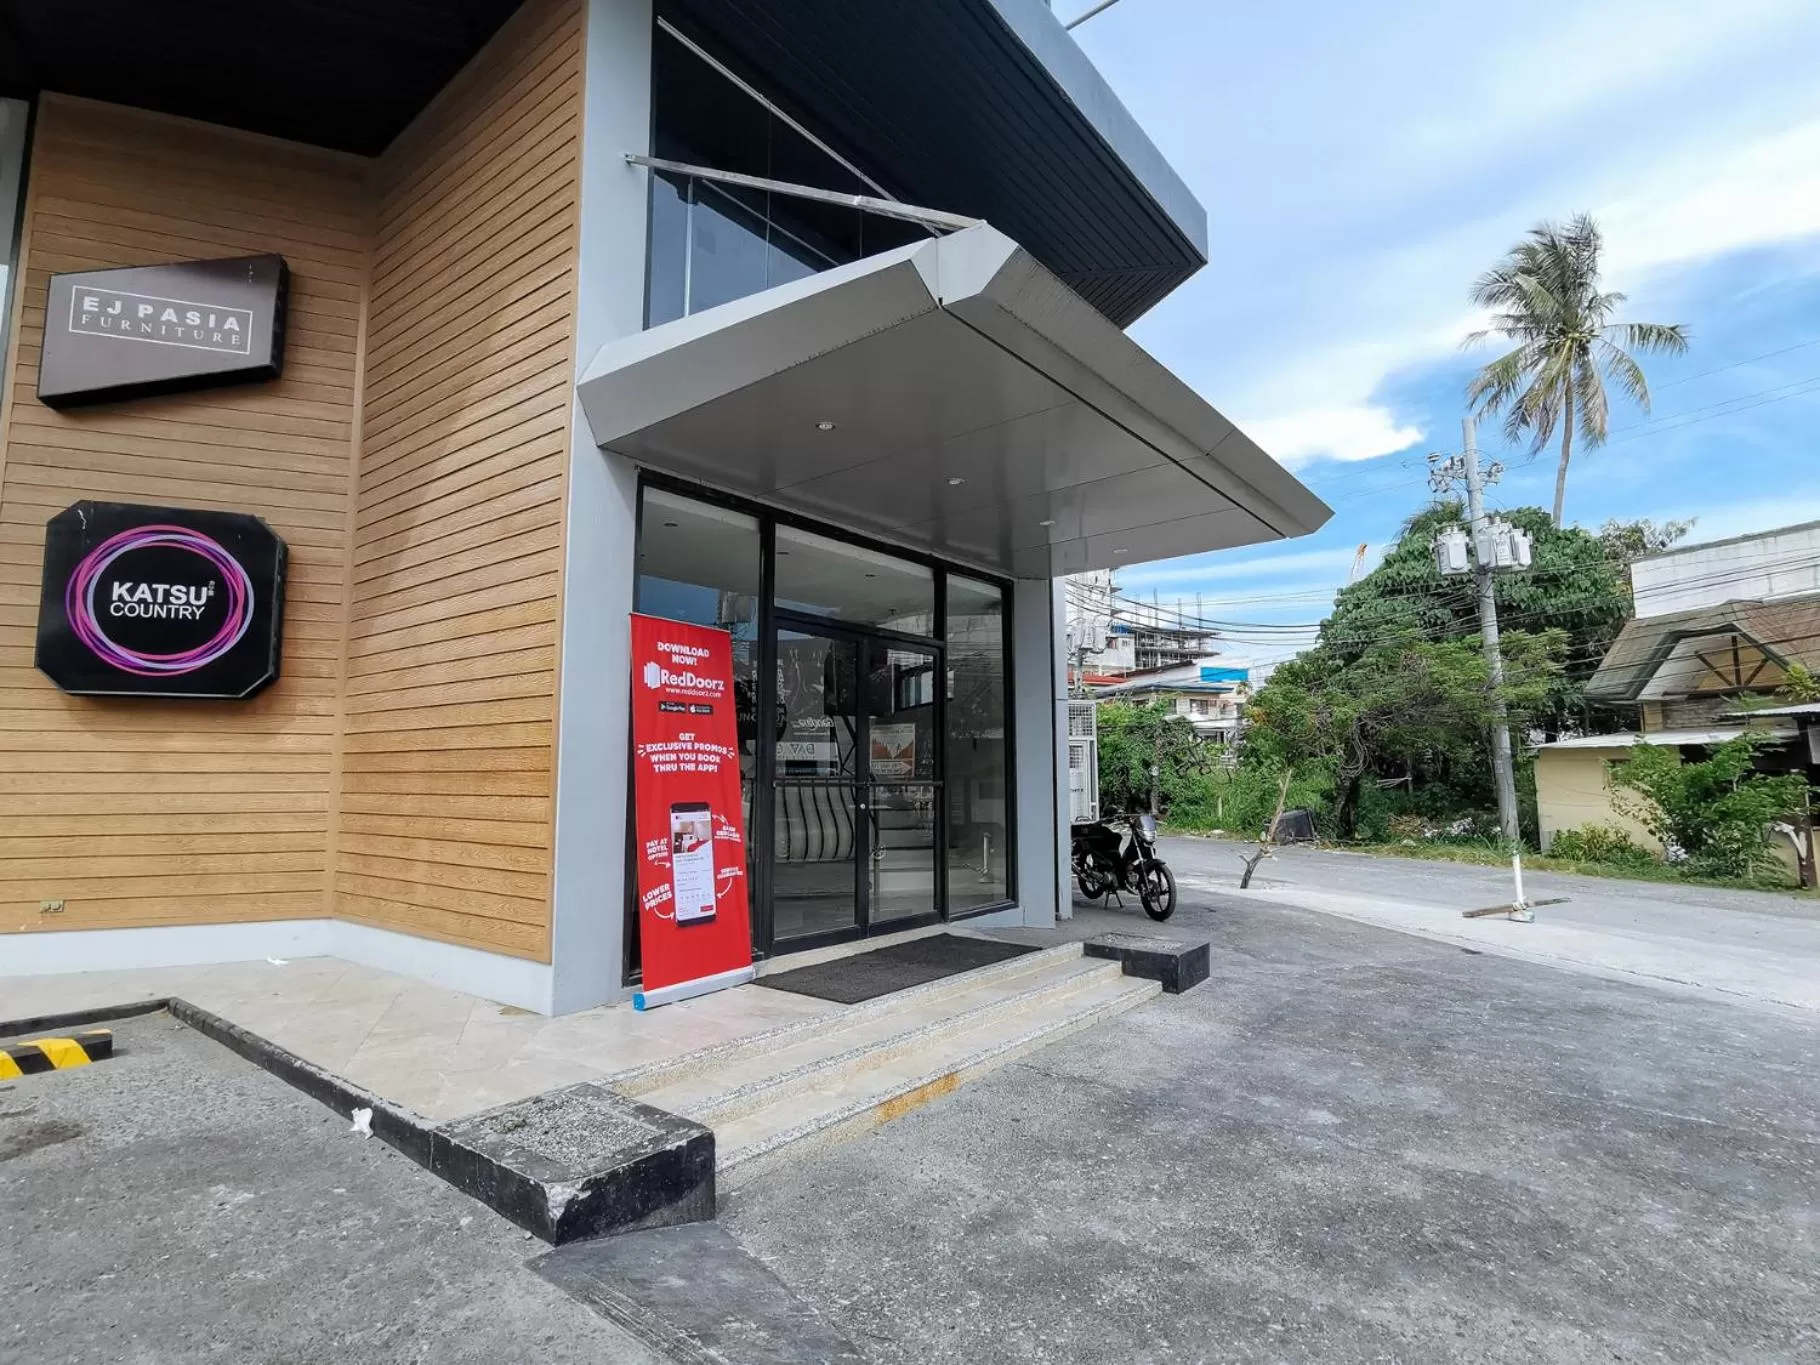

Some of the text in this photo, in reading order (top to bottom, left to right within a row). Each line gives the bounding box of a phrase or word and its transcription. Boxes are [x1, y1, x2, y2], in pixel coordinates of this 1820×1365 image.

[83, 295, 241, 332] EJ PASIA
[81, 314, 241, 344] FURNITURE
[112, 581, 209, 605] KATSU
[110, 602, 205, 620] COUNTRY
[656, 641, 710, 657] DOWNLOAD
[671, 654, 697, 666] NOW!
[661, 669, 725, 691] RedDoorz
[679, 732, 696, 741] GET
[646, 742, 728, 754] EXCLUSIVE PROMOS
[650, 753, 677, 762] WHEN
[679, 753, 696, 761] YOU
[653, 763, 677, 772] THRU
[679, 763, 696, 771] THE
[642, 883, 670, 902] LOWER
